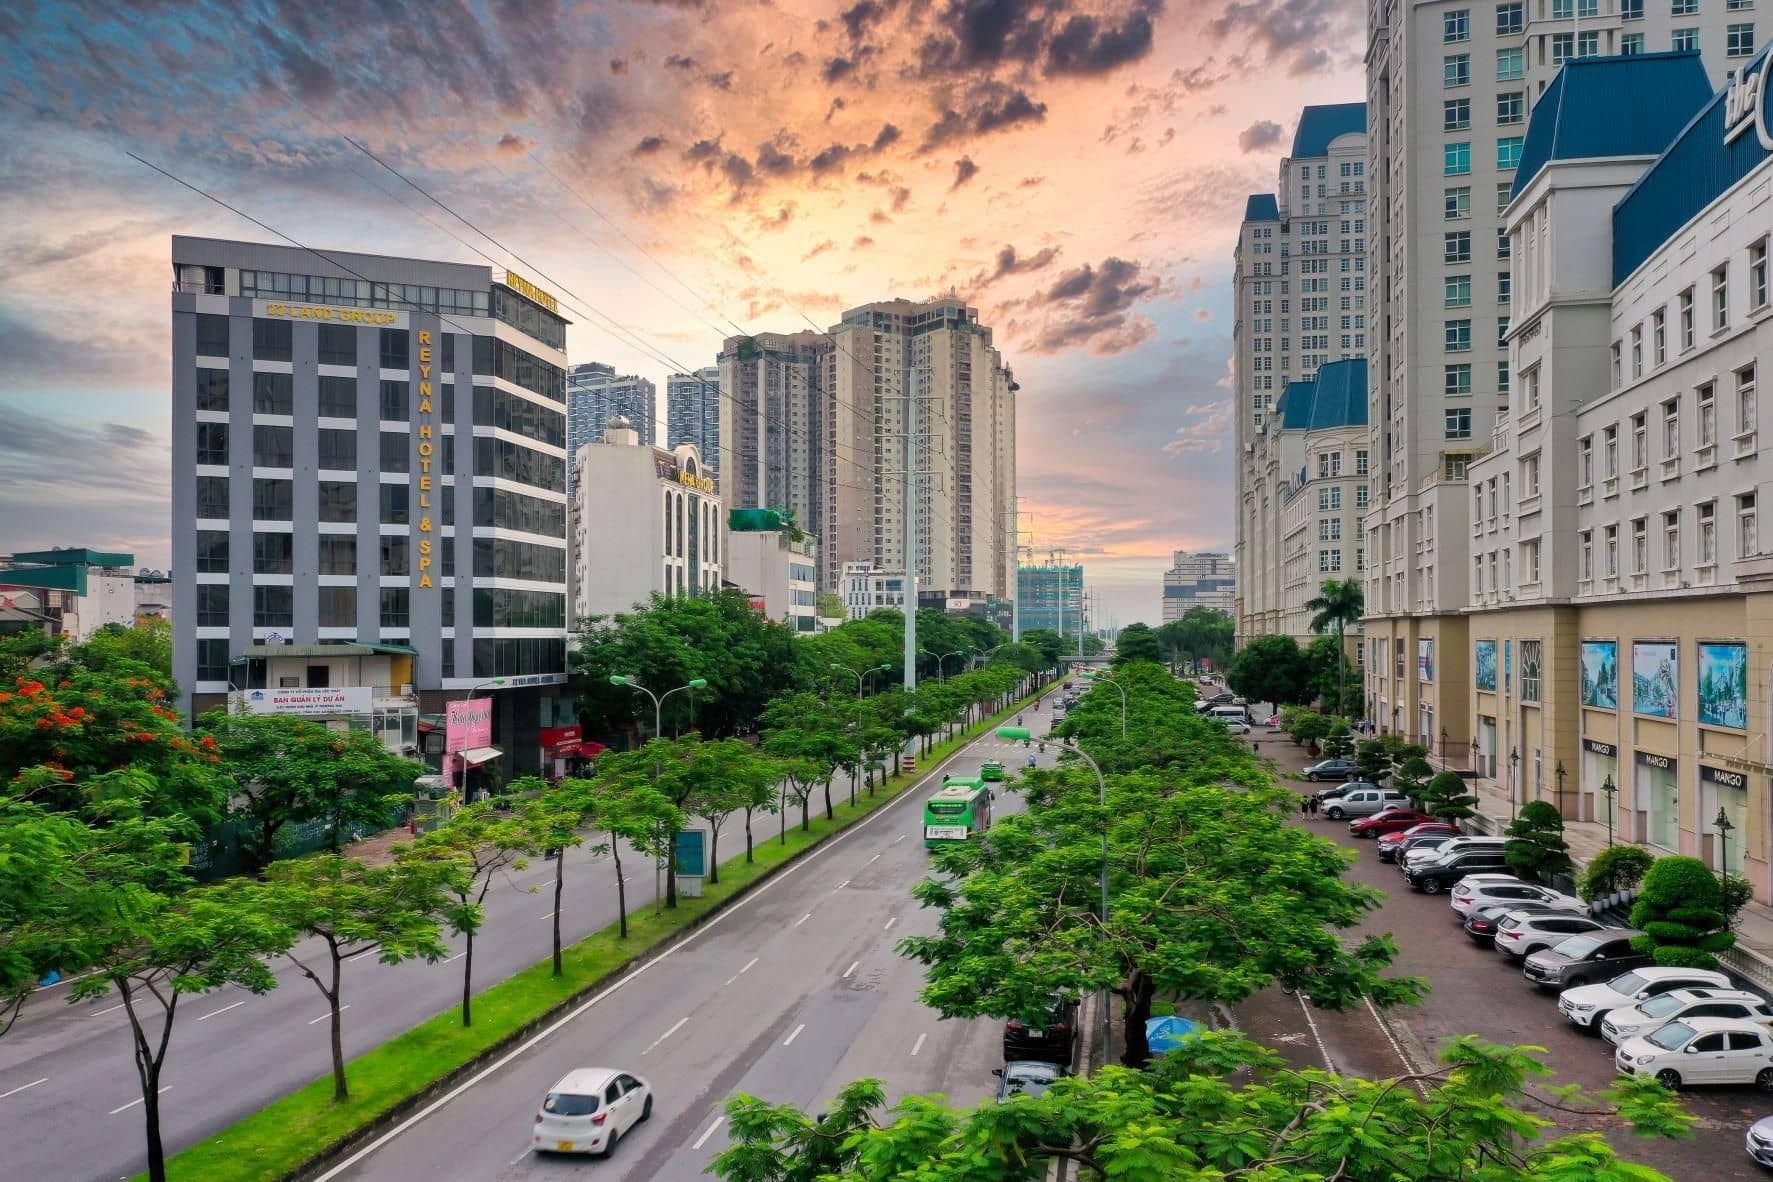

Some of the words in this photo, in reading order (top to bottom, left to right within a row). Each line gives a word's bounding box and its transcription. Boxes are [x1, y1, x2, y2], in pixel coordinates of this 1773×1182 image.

[289, 305, 333, 321] LAND
[340, 309, 396, 325] GROUP
[418, 330, 433, 414] REYNA
[418, 424, 433, 508] HOTEL
[418, 516, 433, 533] &
[418, 539, 433, 589] SPA
[1591, 742, 1610, 754] MANGO
[1646, 754, 1668, 768] MANGO
[1714, 769, 1742, 786] MANGO
